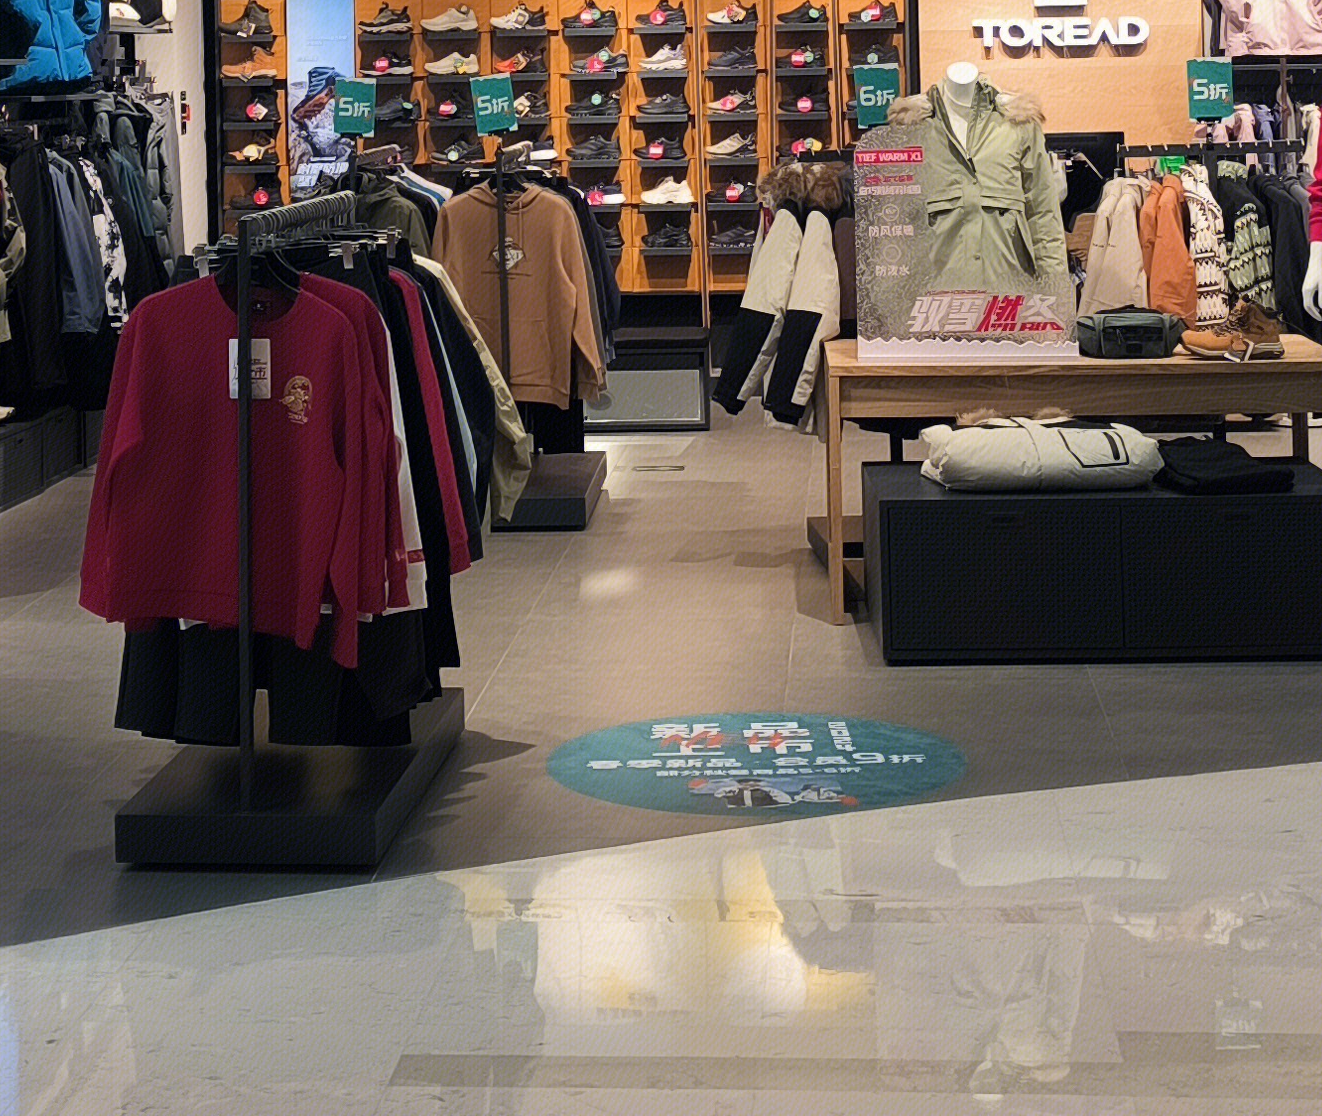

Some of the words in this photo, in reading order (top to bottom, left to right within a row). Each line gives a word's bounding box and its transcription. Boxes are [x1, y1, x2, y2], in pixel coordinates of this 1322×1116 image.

[974, 17, 1150, 48] TOREAD
[859, 86, 896, 107] 6折
[1192, 78, 1230, 104] 5折
[338, 97, 372, 118] 5折
[477, 95, 509, 116] 5折
[879, 152, 908, 162] WARM
[650, 721, 811, 739] 新品
[652, 738, 815, 756] 上市
